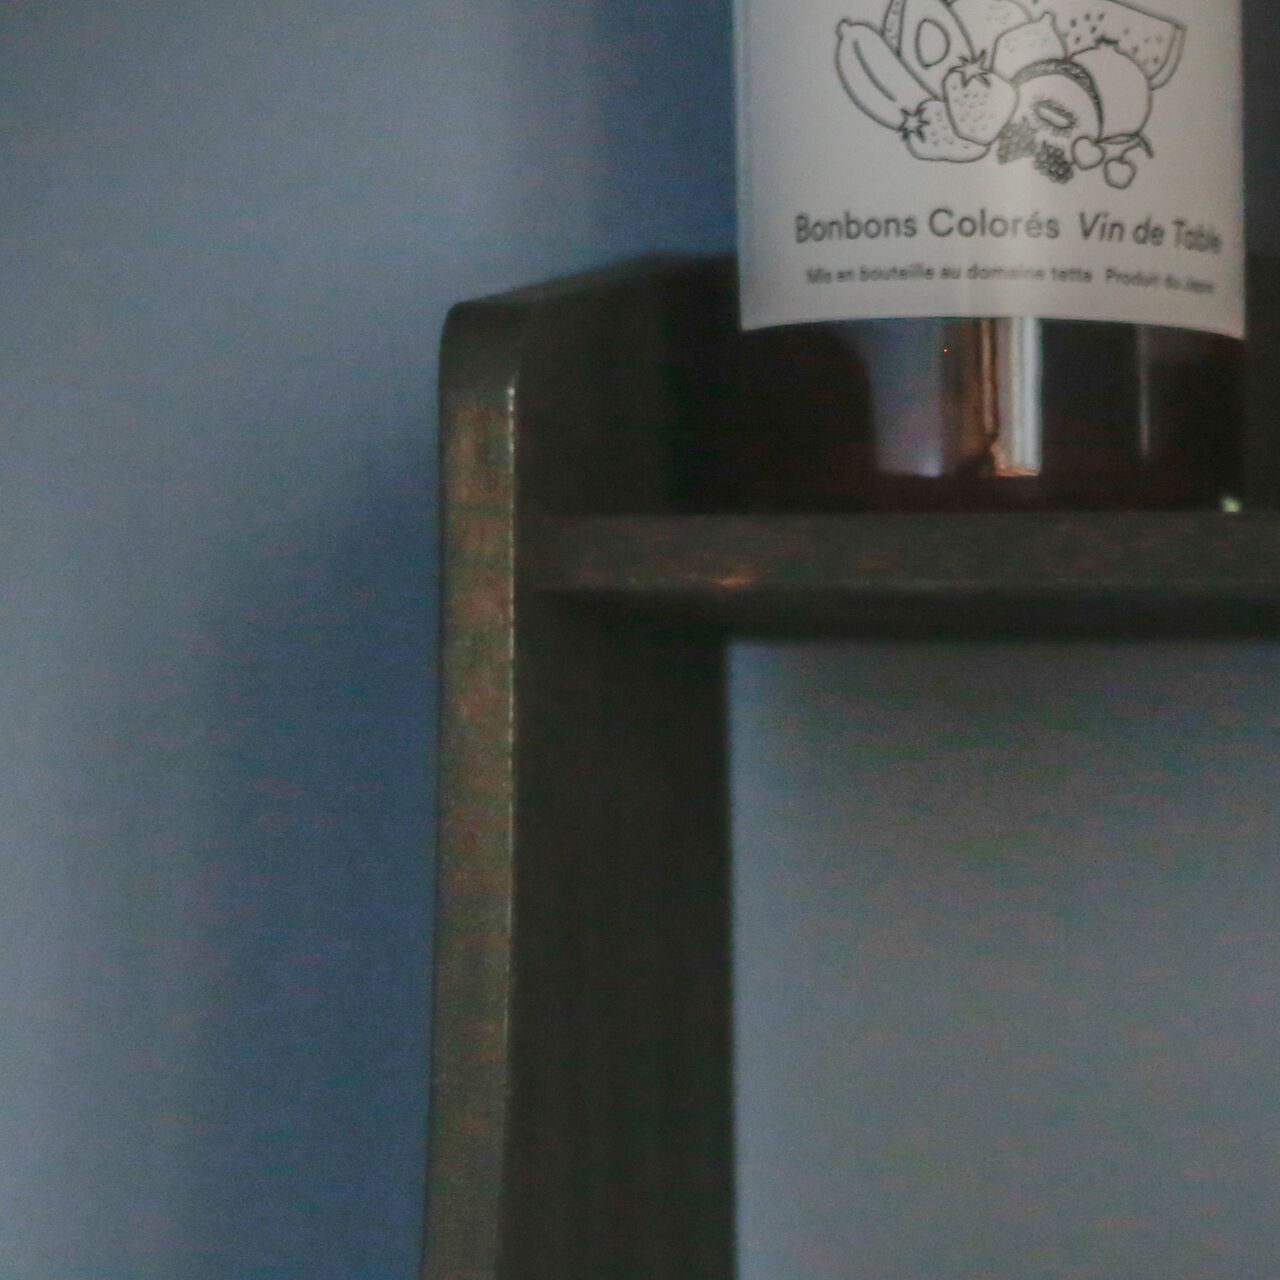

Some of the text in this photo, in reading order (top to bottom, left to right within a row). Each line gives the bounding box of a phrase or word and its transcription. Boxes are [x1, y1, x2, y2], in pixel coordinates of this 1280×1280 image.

[795, 210, 918, 244] Bonbons
[928, 207, 1061, 239] Colorés
[1078, 212, 1126, 242] Vin
[1132, 215, 1165, 246] de
[941, 266, 961, 281] au
